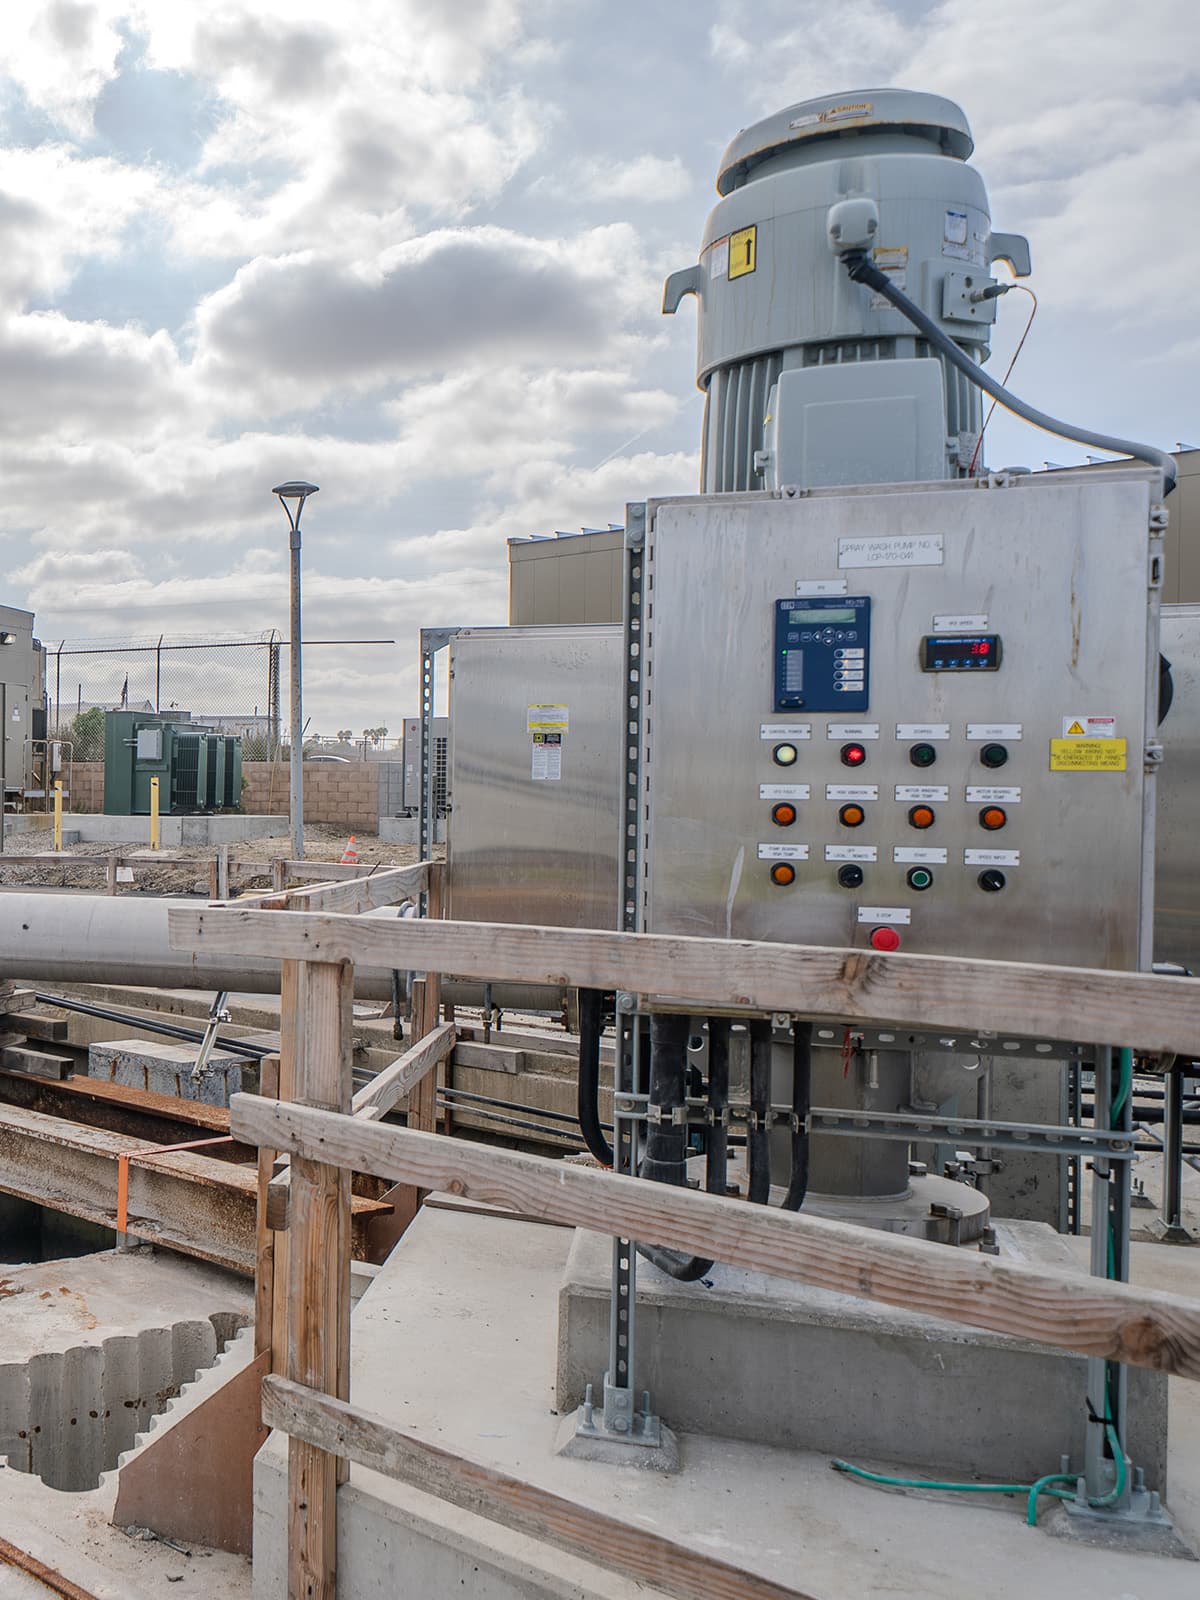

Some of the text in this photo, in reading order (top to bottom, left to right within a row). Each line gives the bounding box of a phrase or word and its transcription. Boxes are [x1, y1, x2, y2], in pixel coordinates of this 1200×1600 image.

[841, 543, 866, 553] SPRAY
[868, 542, 892, 552] WASH
[893, 541, 915, 551] PUMP
